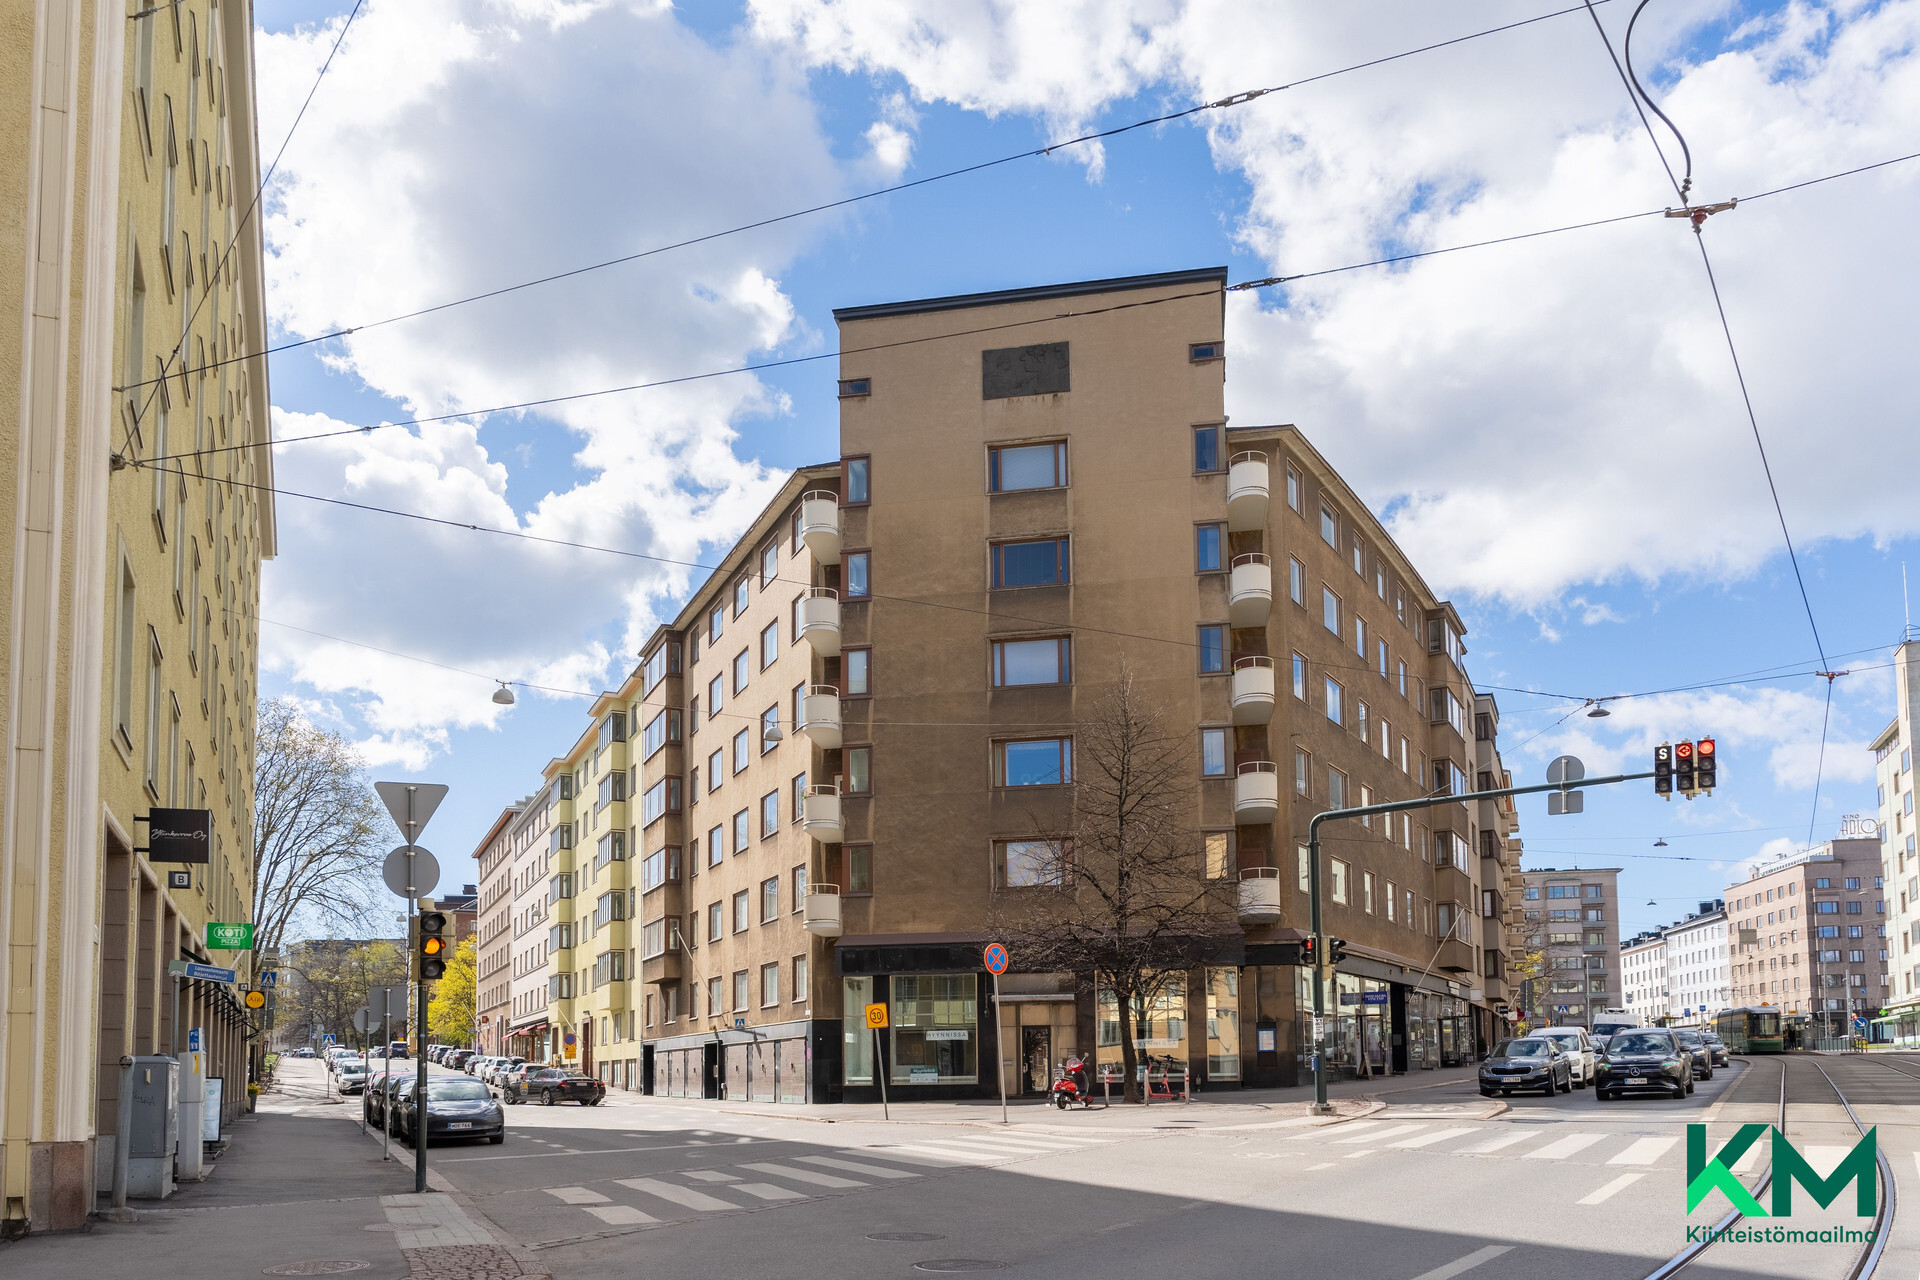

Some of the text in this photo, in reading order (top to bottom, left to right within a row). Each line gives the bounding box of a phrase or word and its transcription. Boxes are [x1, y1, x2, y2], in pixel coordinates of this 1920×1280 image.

[178, 875, 185, 884] B
[217, 927, 244, 937] KOTI
[871, 1011, 882, 1021] 30
